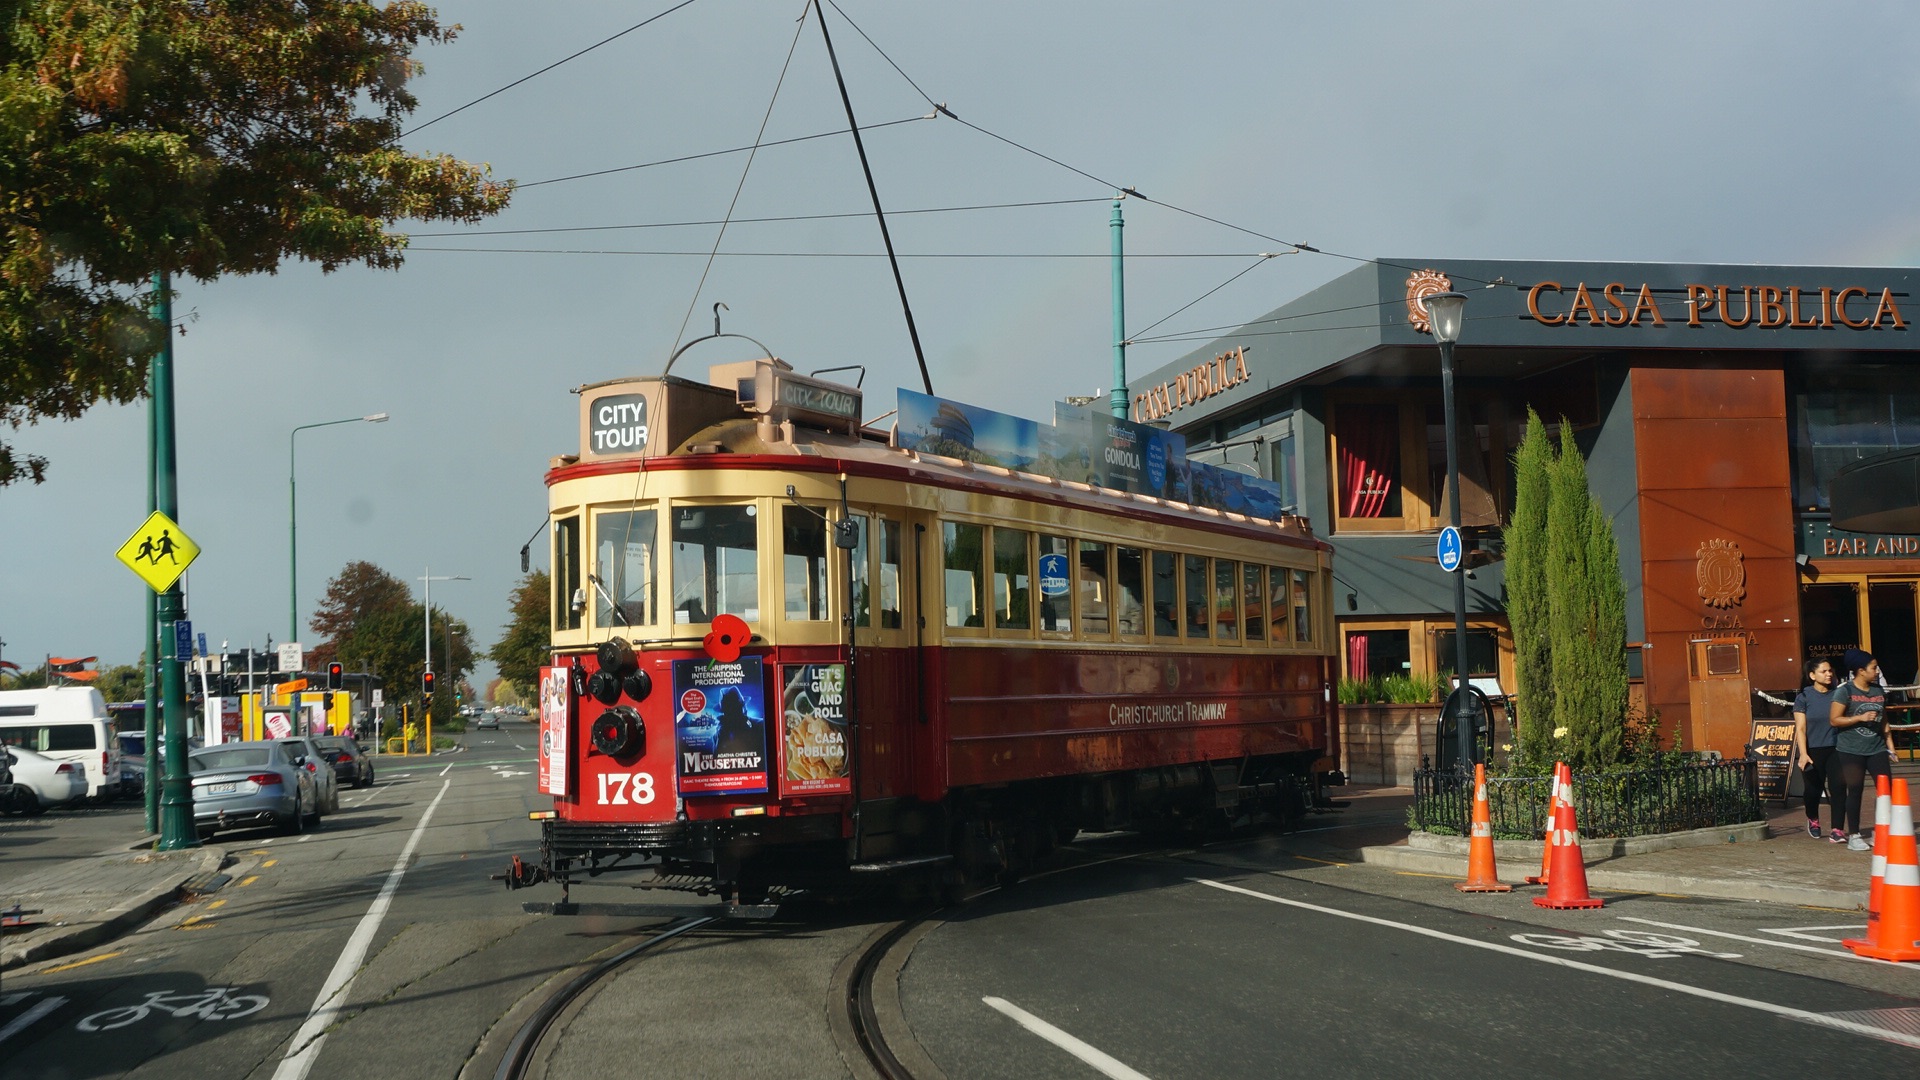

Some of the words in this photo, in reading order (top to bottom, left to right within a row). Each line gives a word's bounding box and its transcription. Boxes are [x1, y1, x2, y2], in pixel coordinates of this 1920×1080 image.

[1527, 281, 1665, 325] CASA
[1684, 283, 1906, 328] PUBLICA
[1133, 382, 1172, 423] CASA
[1176, 346, 1249, 409] PUBLICA
[785, 384, 812, 406] CITY
[820, 390, 852, 414] TOUR
[599, 402, 643, 426] CITY
[594, 425, 648, 449] TOUR
[1105, 447, 1140, 470] GONDOLA
[1824, 538, 1867, 555] BAR
[1874, 537, 1919, 554] AND
[1701, 615, 1744, 629] CASA
[692, 670, 745, 679] INTERNATIONAL
[812, 669, 841, 680] LET'S
[811, 681, 842, 693] GUAC
[818, 694, 842, 706] AND
[814, 707, 843, 718] ROLL
[1109, 703, 1184, 725] CHRISTCHURCH
[1186, 701, 1227, 721] TRAMWAY
[815, 733, 844, 743] CASA
[797, 746, 844, 757] PUBLICA
[683, 752, 761, 773] MOUSETRAP
[597, 772, 655, 805] 178
